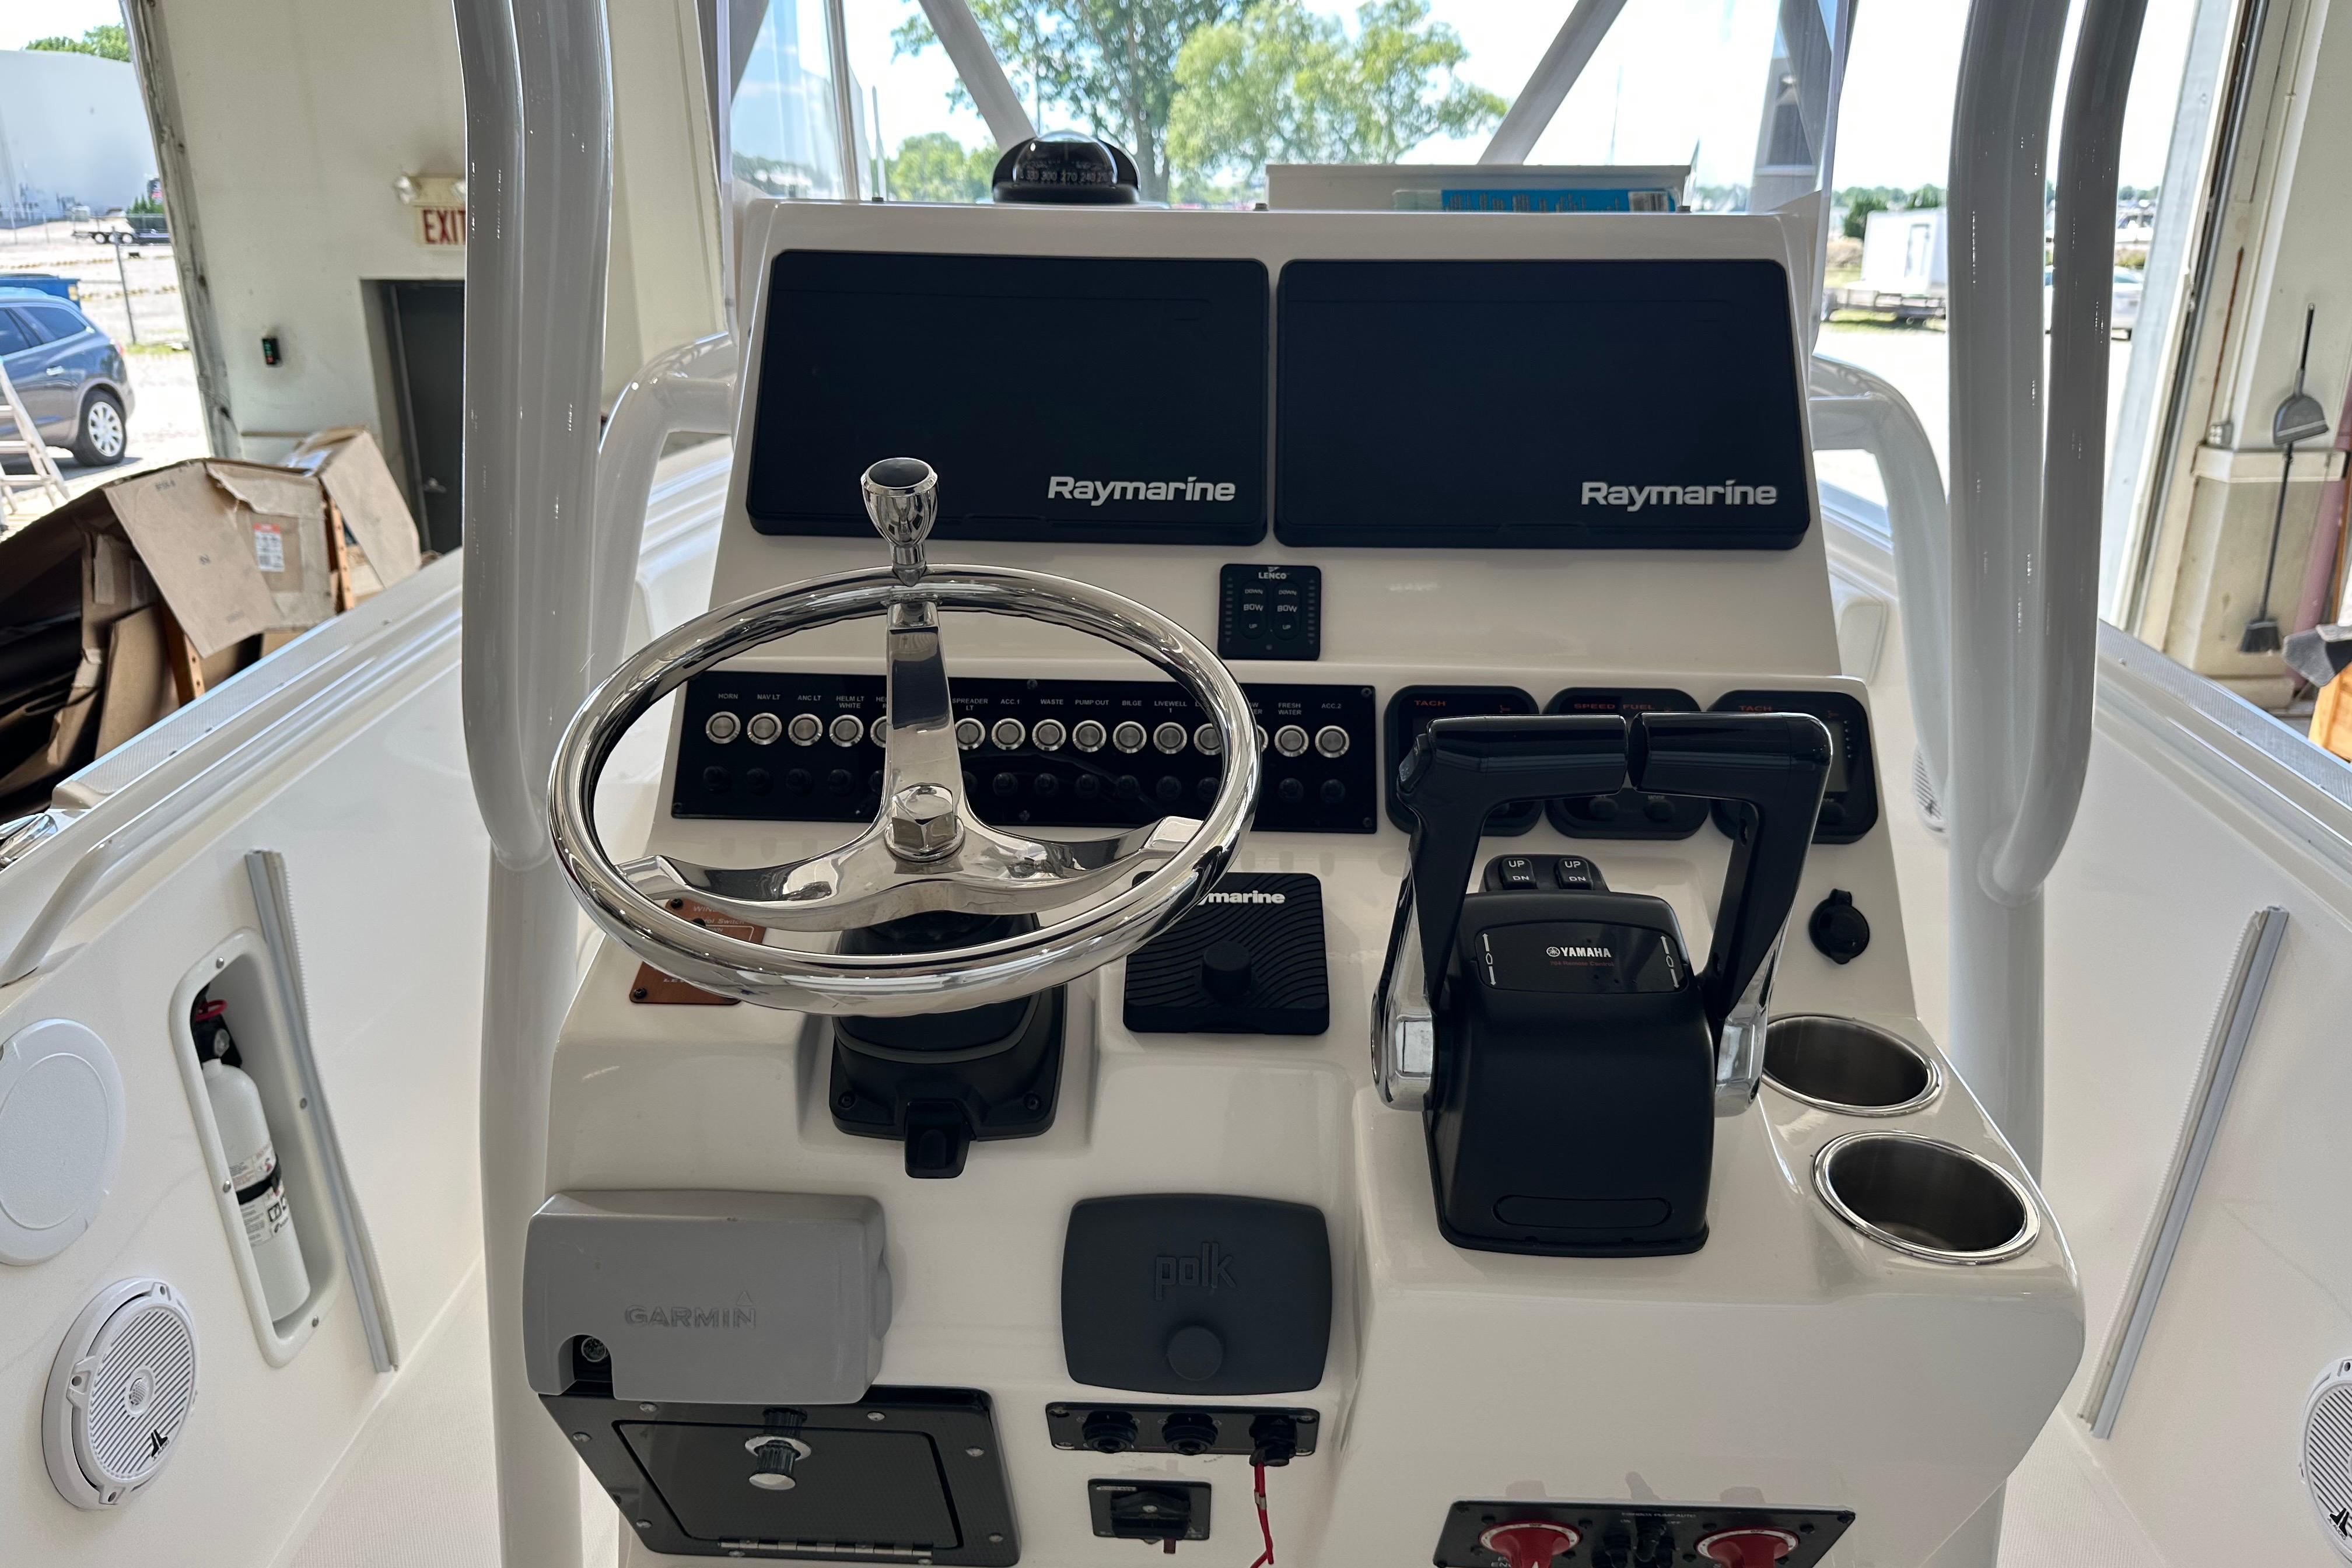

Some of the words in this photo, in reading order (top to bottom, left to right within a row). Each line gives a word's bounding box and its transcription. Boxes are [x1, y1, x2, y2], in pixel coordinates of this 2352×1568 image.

[1041, 170, 1058, 181] 300
[422, 209, 466, 246] EXIT
[1048, 476, 1236, 506] Raymarine
[1581, 480, 1778, 512] Raymarine
[1508, 859, 1525, 868] UP
[1564, 860, 1581, 869] UP
[1197, 890, 1285, 905] marine
[1560, 947, 1612, 958] YAMAHA
[1154, 1242, 1237, 1301] polk
[624, 1304, 757, 1329] GARMIN
